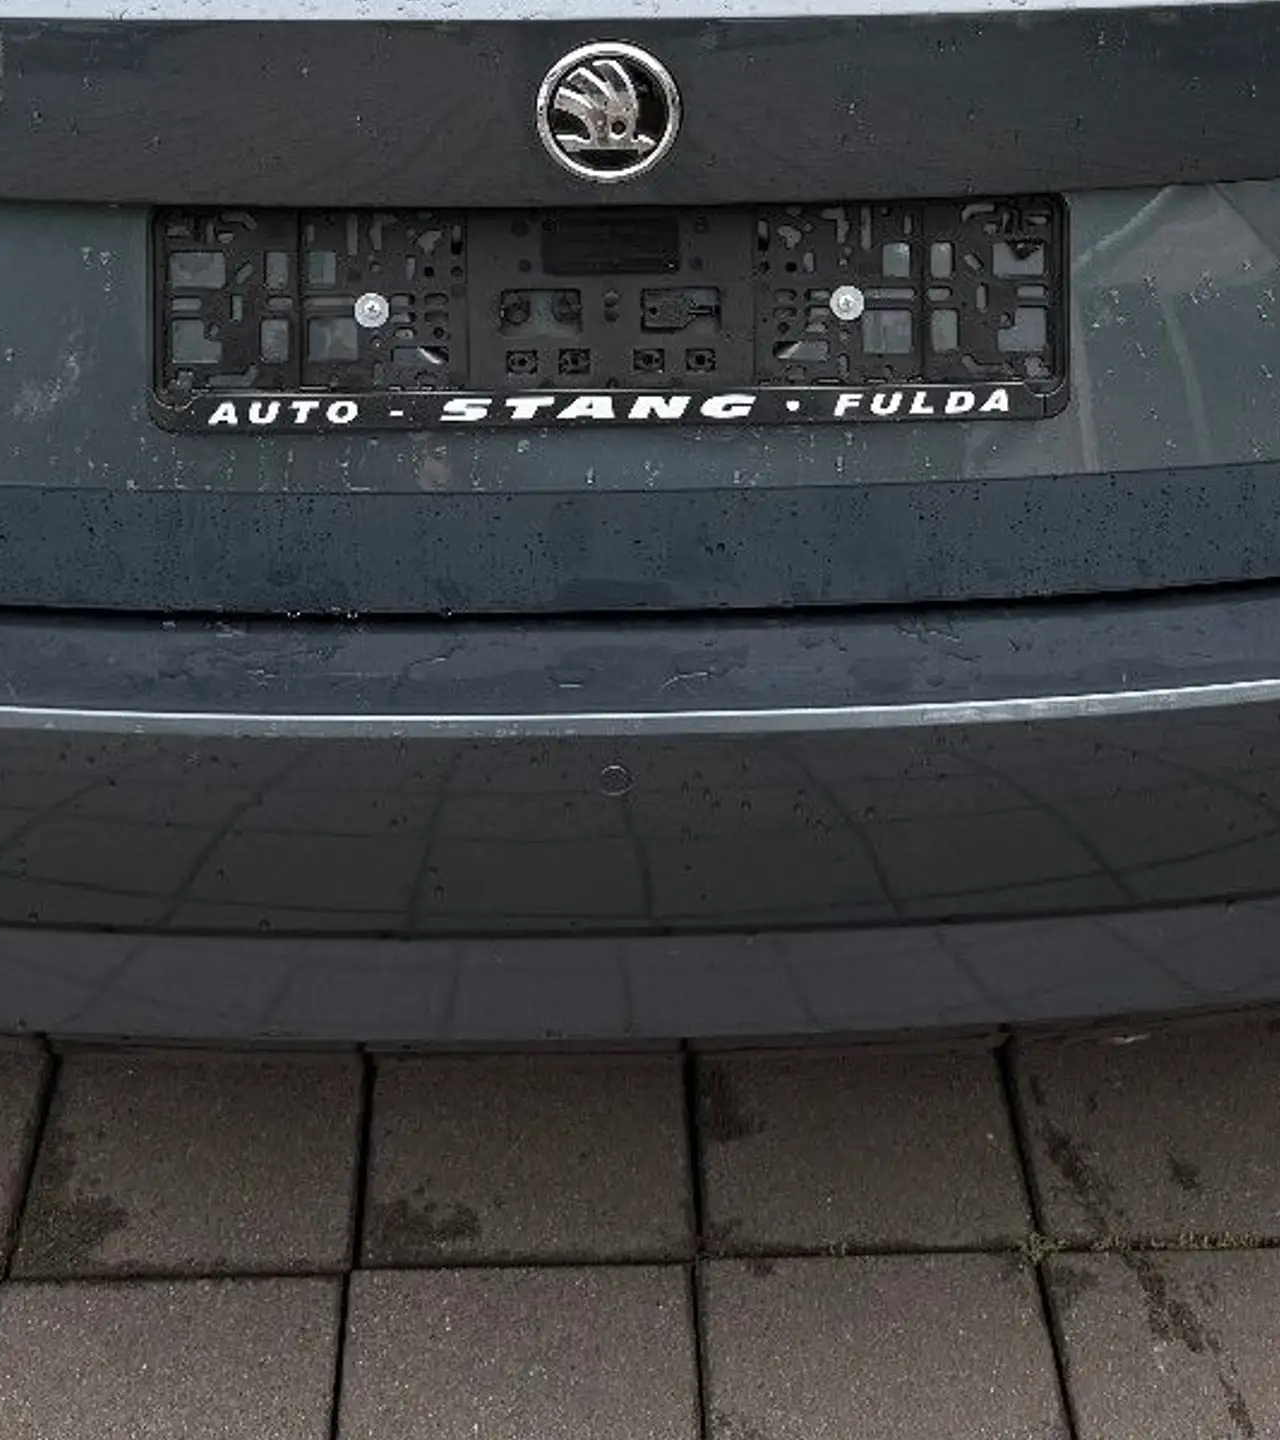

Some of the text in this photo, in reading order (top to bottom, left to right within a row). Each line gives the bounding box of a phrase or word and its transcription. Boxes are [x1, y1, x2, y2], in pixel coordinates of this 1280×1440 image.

[207, 399, 360, 427] AUTO
[439, 395, 757, 422] STANG
[832, 388, 1010, 418] FULDA
